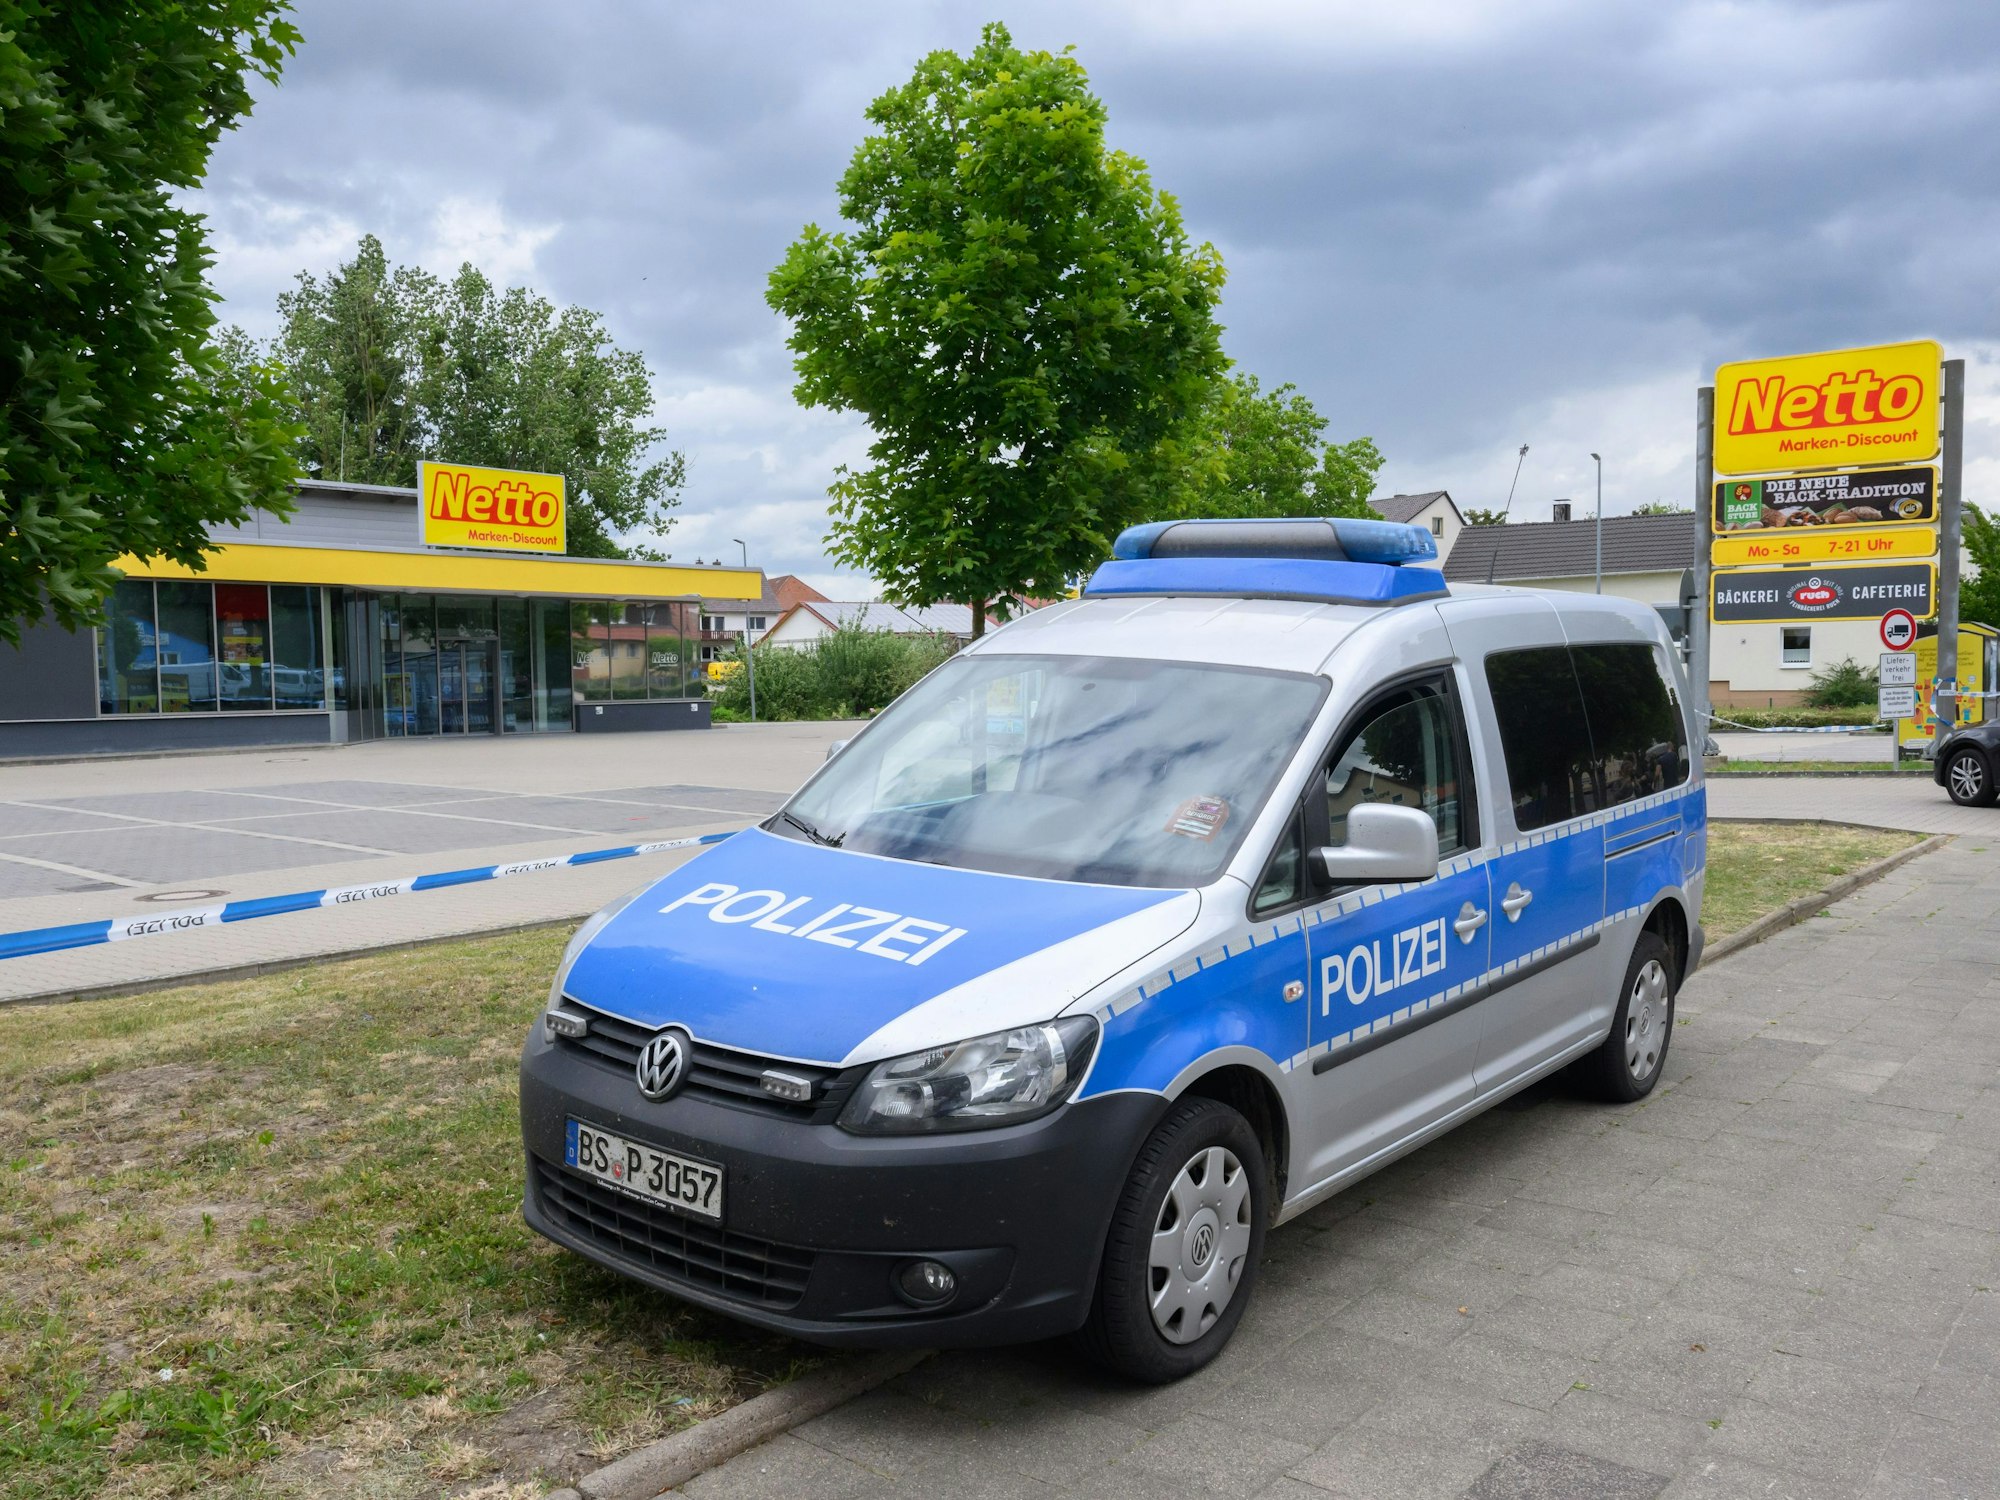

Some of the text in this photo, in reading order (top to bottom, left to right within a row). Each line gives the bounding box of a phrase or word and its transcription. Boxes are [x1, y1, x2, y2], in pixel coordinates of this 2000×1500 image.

[1728, 369, 1923, 435] Netto
[1779, 429, 1918, 452] Marken-Discount
[1766, 475, 1849, 492] DIE NEUE
[1773, 482, 1926, 504] BACK-TRADITION
[430, 471, 559, 528] Netto
[1727, 503, 1758, 513] BACK
[1728, 511, 1758, 520] STUBE
[468, 530, 557, 545] Marken-Discount
[1748, 546, 1769, 557] Mo
[1782, 544, 1800, 555] Sa
[1829, 540, 1860, 553] 7-21
[1867, 539, 1893, 551] Uhr
[1717, 589, 1779, 604] BÄCKEREI
[1852, 583, 1927, 599] CAFETERIE
[652, 652, 679, 664] Netto
[1886, 656, 1910, 664] Liefer-
[335, 879, 400, 903] POLIZEI
[127, 913, 206, 936] POLIZEI
[657, 882, 968, 966] POLIZEI
[1321, 917, 1447, 1017] POLIZEI
[580, 1129, 609, 1173] BS
[627, 1146, 642, 1182] P
[648, 1154, 718, 1209] 3057
